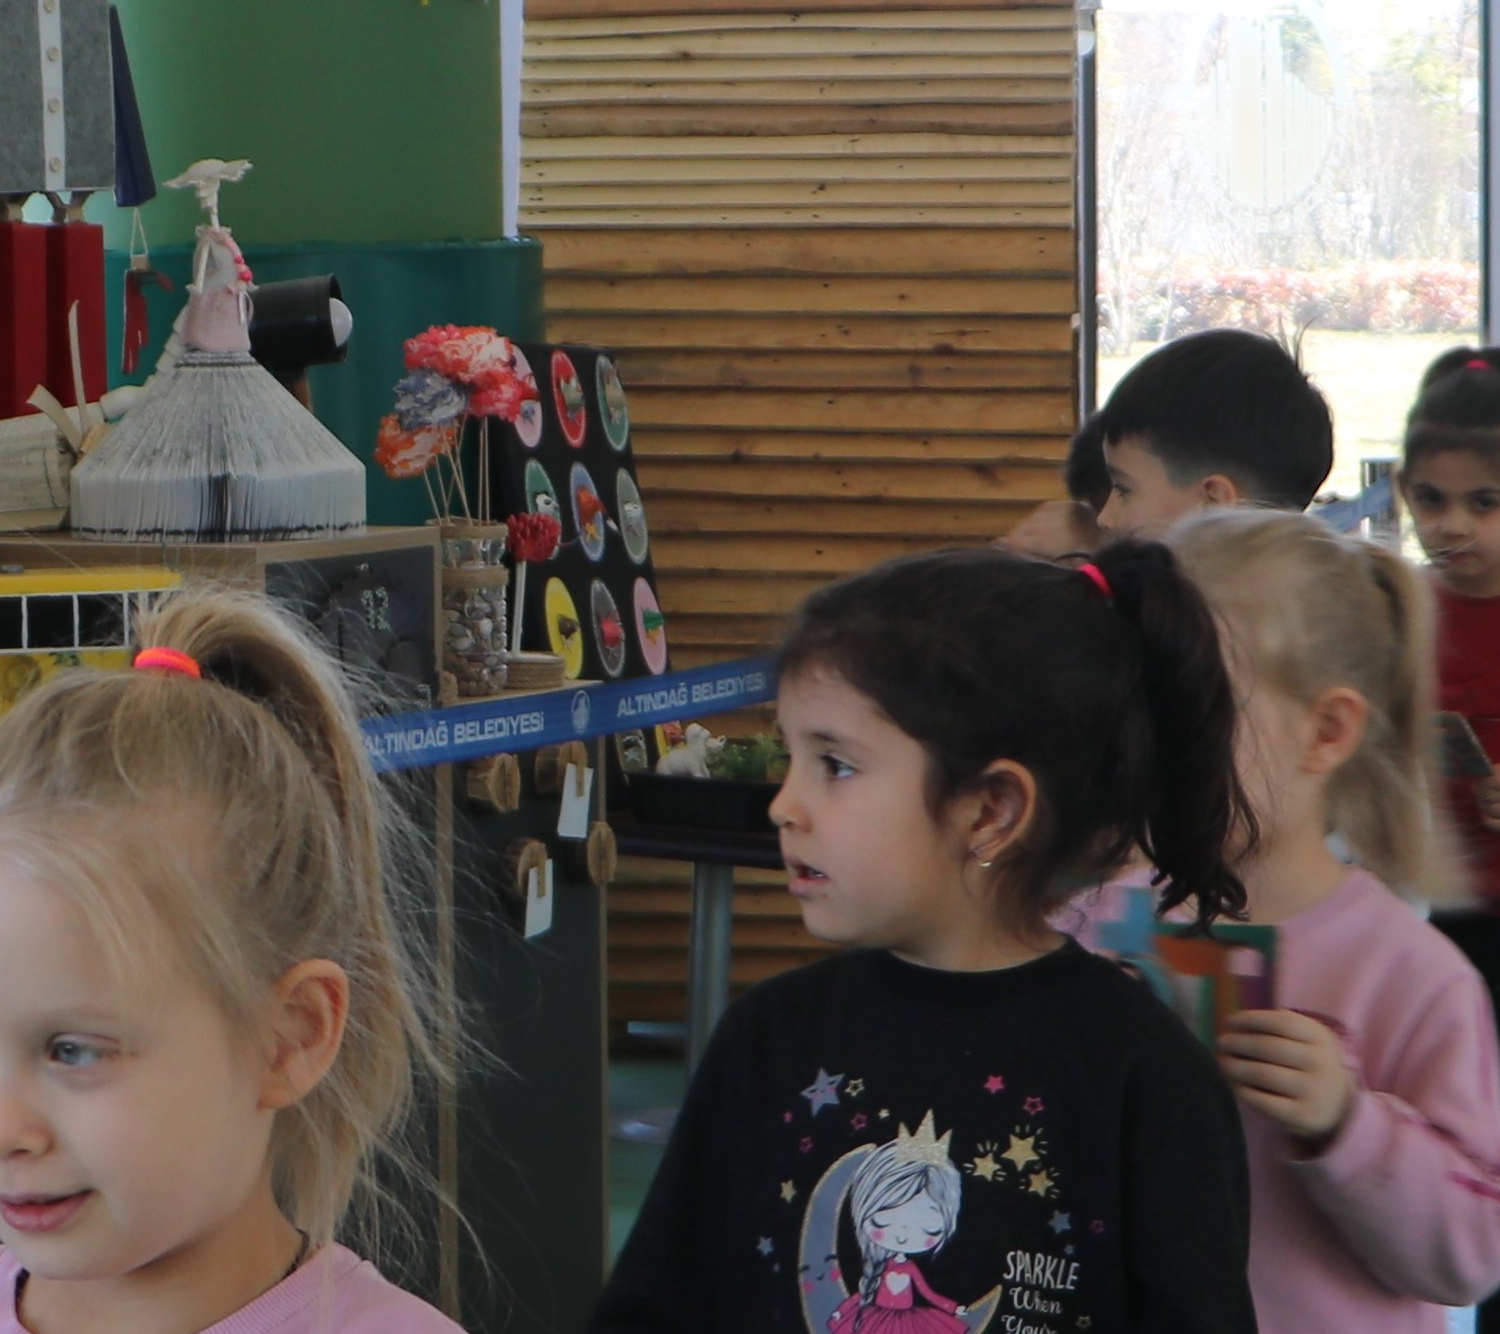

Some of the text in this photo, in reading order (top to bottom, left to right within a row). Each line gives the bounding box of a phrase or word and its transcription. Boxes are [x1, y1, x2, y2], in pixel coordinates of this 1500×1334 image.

[617, 682, 688, 717] ALTINDAĞ
[1003, 1250, 1080, 1289] SPARKLE
[1009, 1287, 1062, 1315] When
